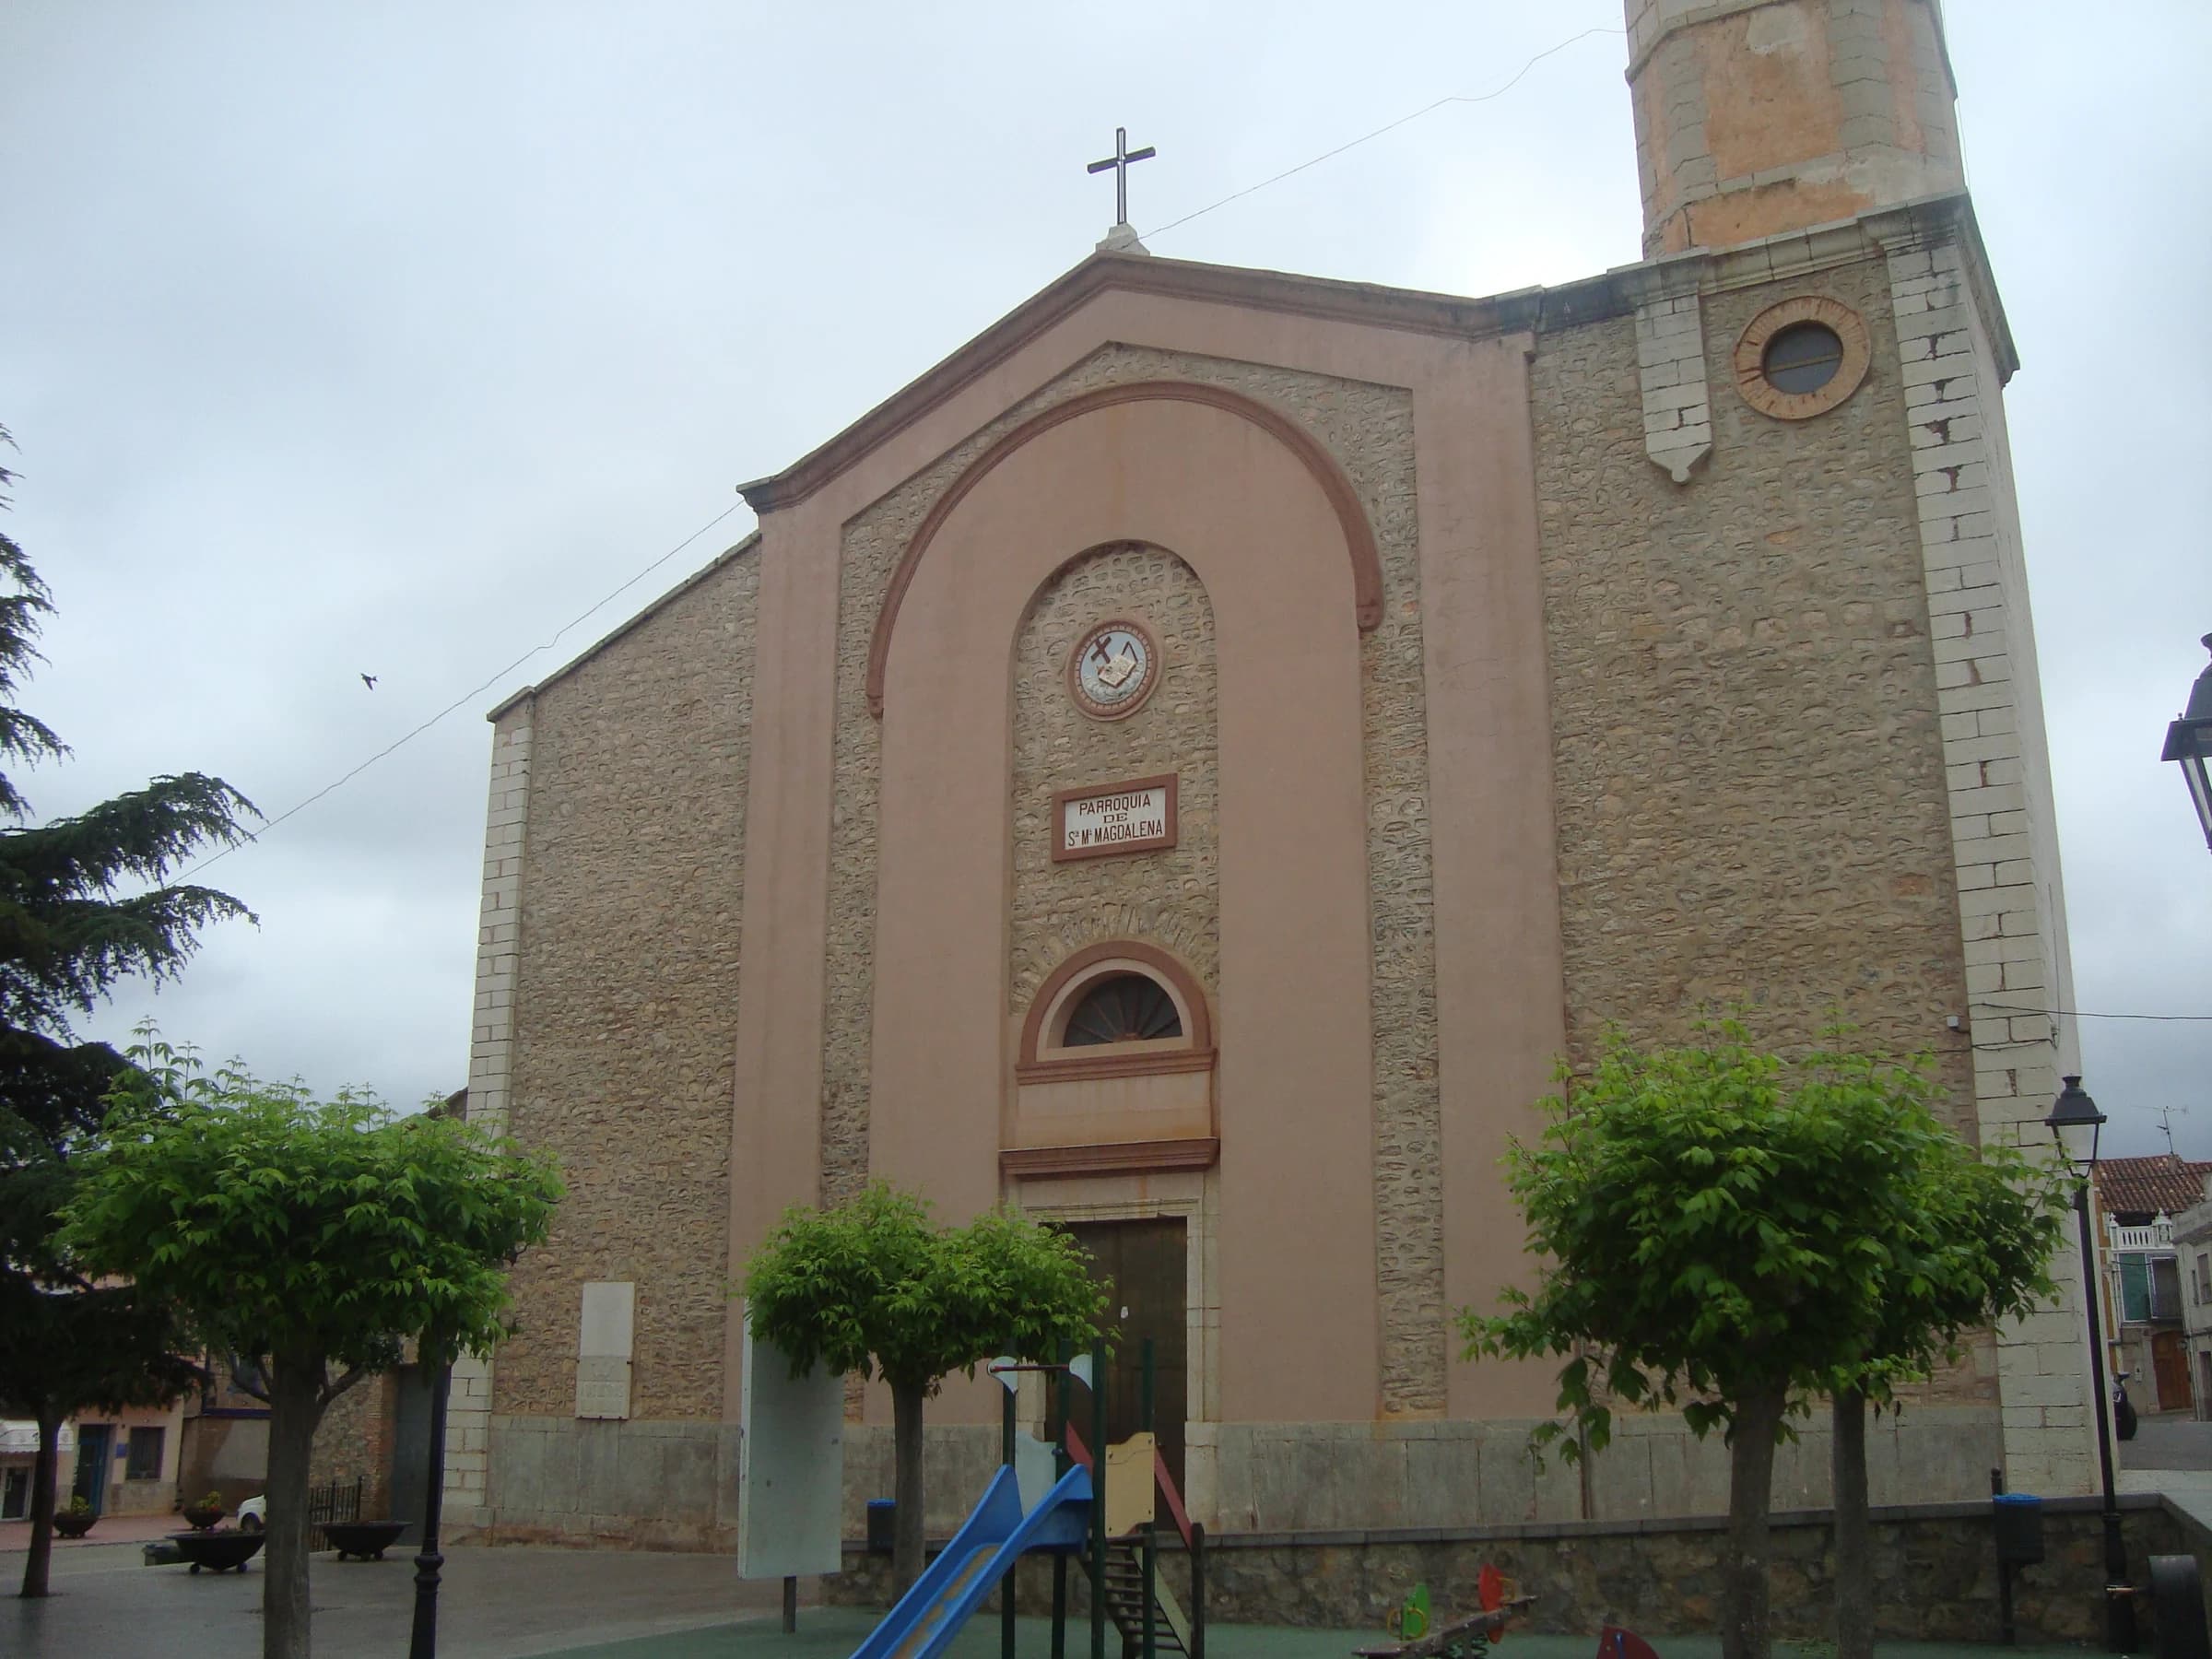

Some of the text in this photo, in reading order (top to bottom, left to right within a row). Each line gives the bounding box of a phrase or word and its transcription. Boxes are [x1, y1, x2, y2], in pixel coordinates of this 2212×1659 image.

[1079, 794, 1151, 816] PARROQUIA
[1103, 812, 1128, 824] DE
[1094, 818, 1163, 843] MAGDALENA
